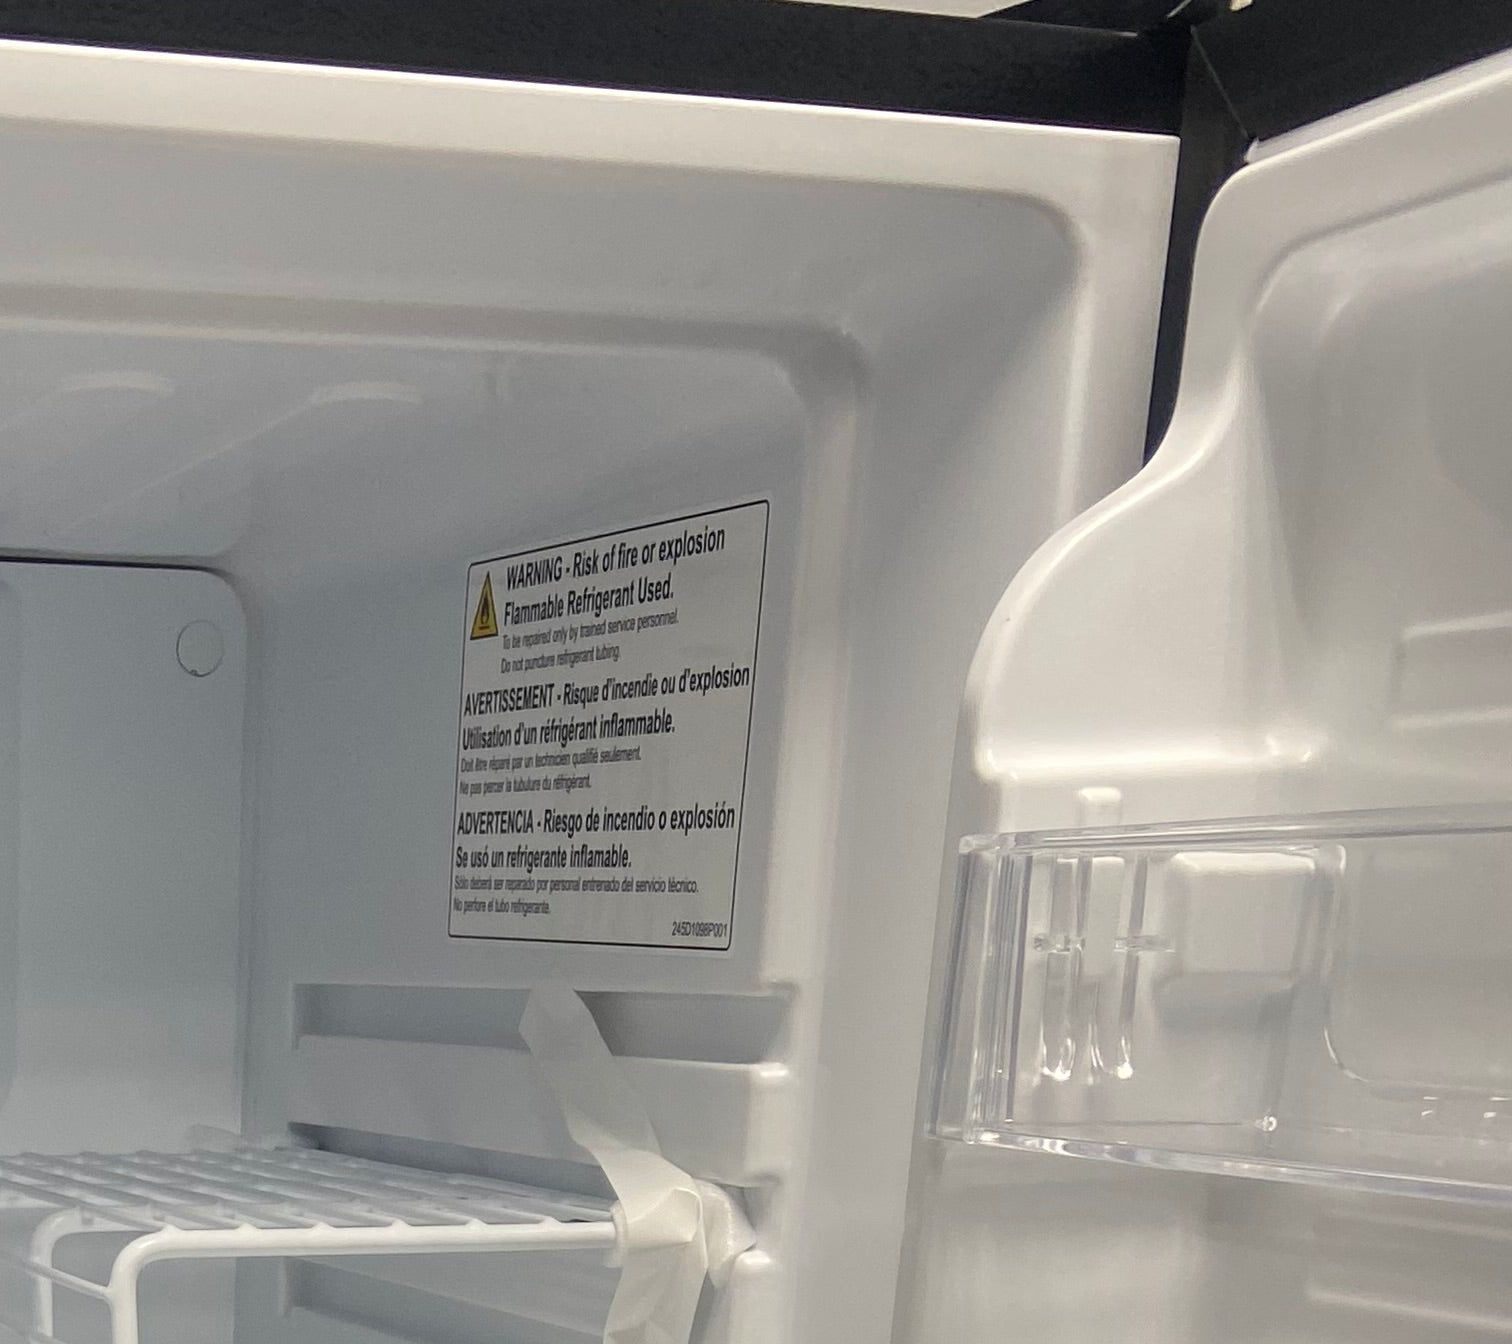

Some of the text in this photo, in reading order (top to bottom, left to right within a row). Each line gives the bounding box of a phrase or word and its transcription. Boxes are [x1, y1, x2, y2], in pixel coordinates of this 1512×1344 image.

[506, 555, 562, 591] WARNING
[572, 548, 599, 578] Risk
[601, 543, 616, 572] of
[617, 541, 638, 569] fire
[641, 542, 656, 565] or
[658, 524, 725, 566] explosion
[503, 571, 673, 626] Flammable Refrigerant Used.
[463, 682, 555, 716] AVERTISSEMENT
[562, 681, 599, 709] Risque
[601, 672, 658, 701] d'incendie
[660, 675, 676, 695] ou
[678, 661, 750, 696] d'explosion
[461, 706, 675, 751] Utilisation d'un réfrigérant inflammable.
[457, 808, 534, 835] ADVERTENCIA
[542, 807, 583, 839] Riesgo
[584, 806, 600, 832] de
[602, 804, 655, 831] incendio
[657, 810, 667, 831] o
[669, 800, 735, 836] explosión
[455, 842, 631, 874] Se usó un refrigerante inflamable.
